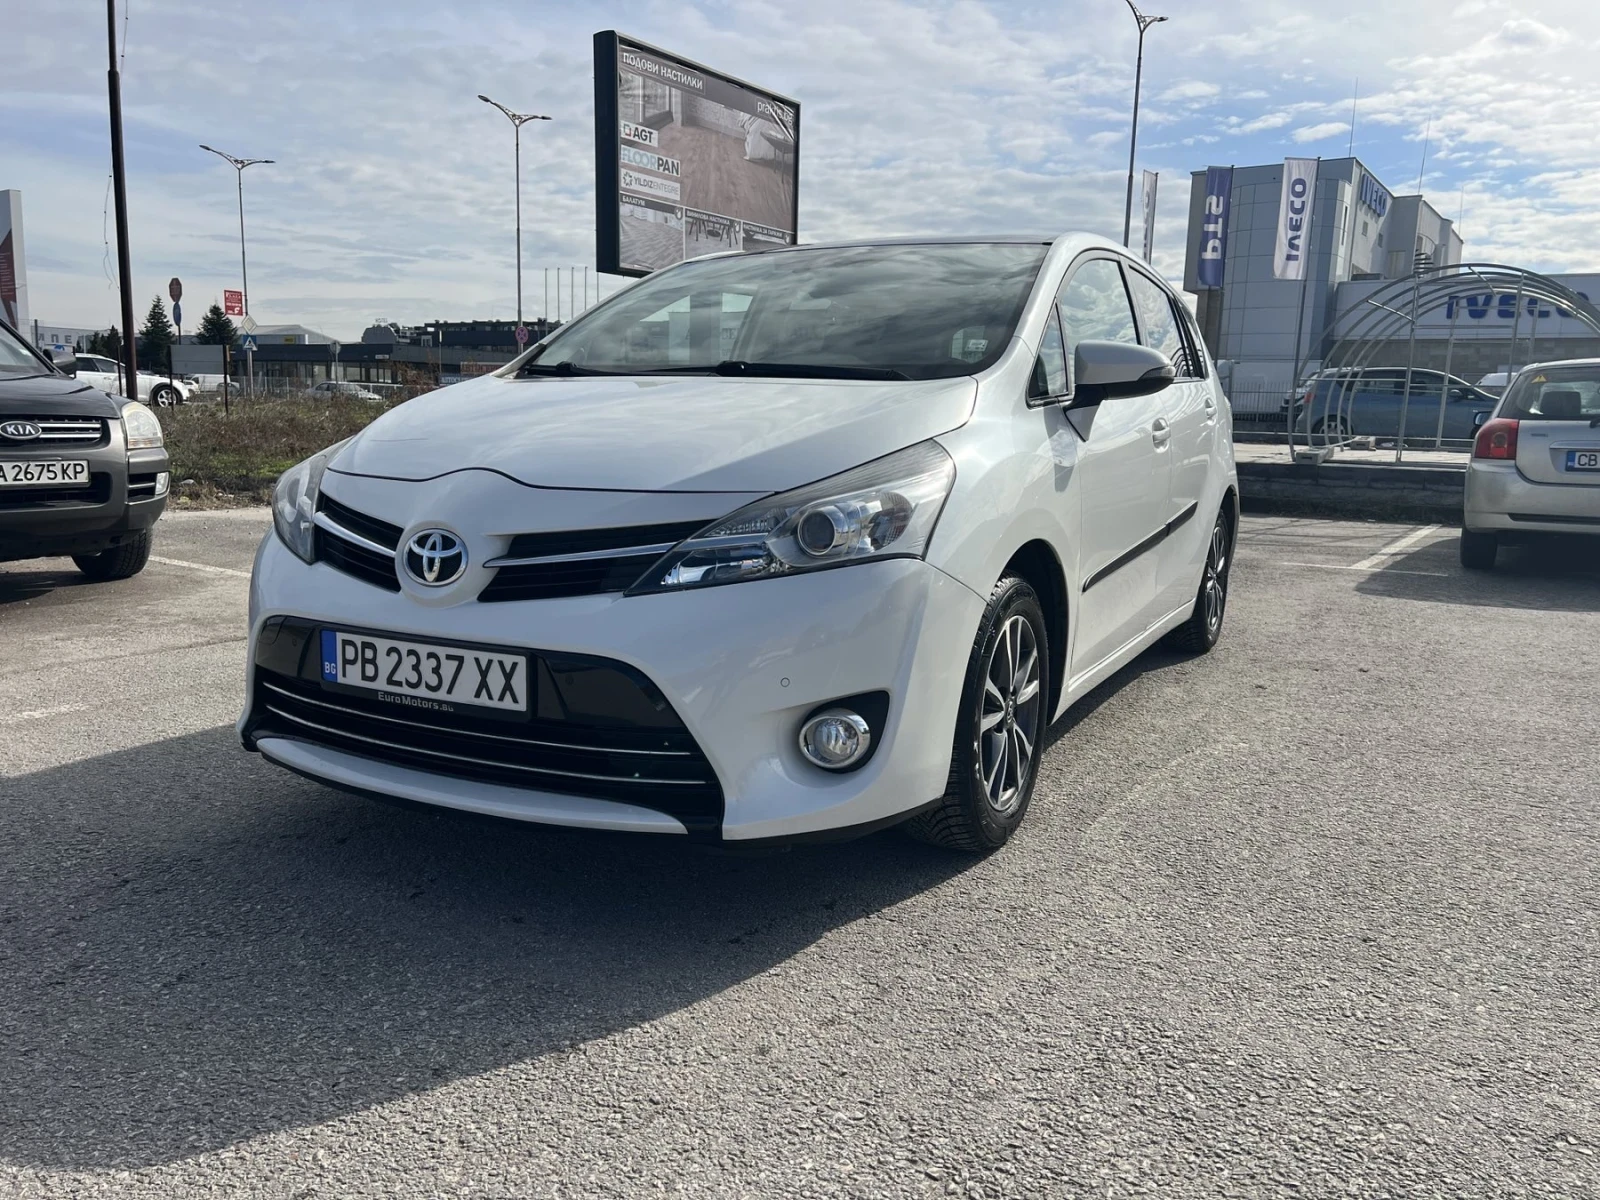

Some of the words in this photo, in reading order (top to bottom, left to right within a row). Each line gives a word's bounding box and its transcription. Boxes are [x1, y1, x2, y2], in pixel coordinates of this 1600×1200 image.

[623, 52, 659, 74] ПОДОВИ
[660, 66, 703, 90] НАСТИЛКИ
[633, 126, 654, 143] AGT
[621, 147, 680, 176] FLOORPAN
[622, 195, 645, 206] БАЛАТУМ
[1360, 173, 1388, 217] IVECO
[6, 424, 36, 435] KIA
[1577, 454, 1598, 467] CB
[12, 463, 58, 482] 2675
[61, 463, 85, 481] KP
[324, 661, 337, 675] BG
[341, 638, 379, 683] PB
[386, 646, 465, 695] 2337
[473, 656, 519, 704] XX
